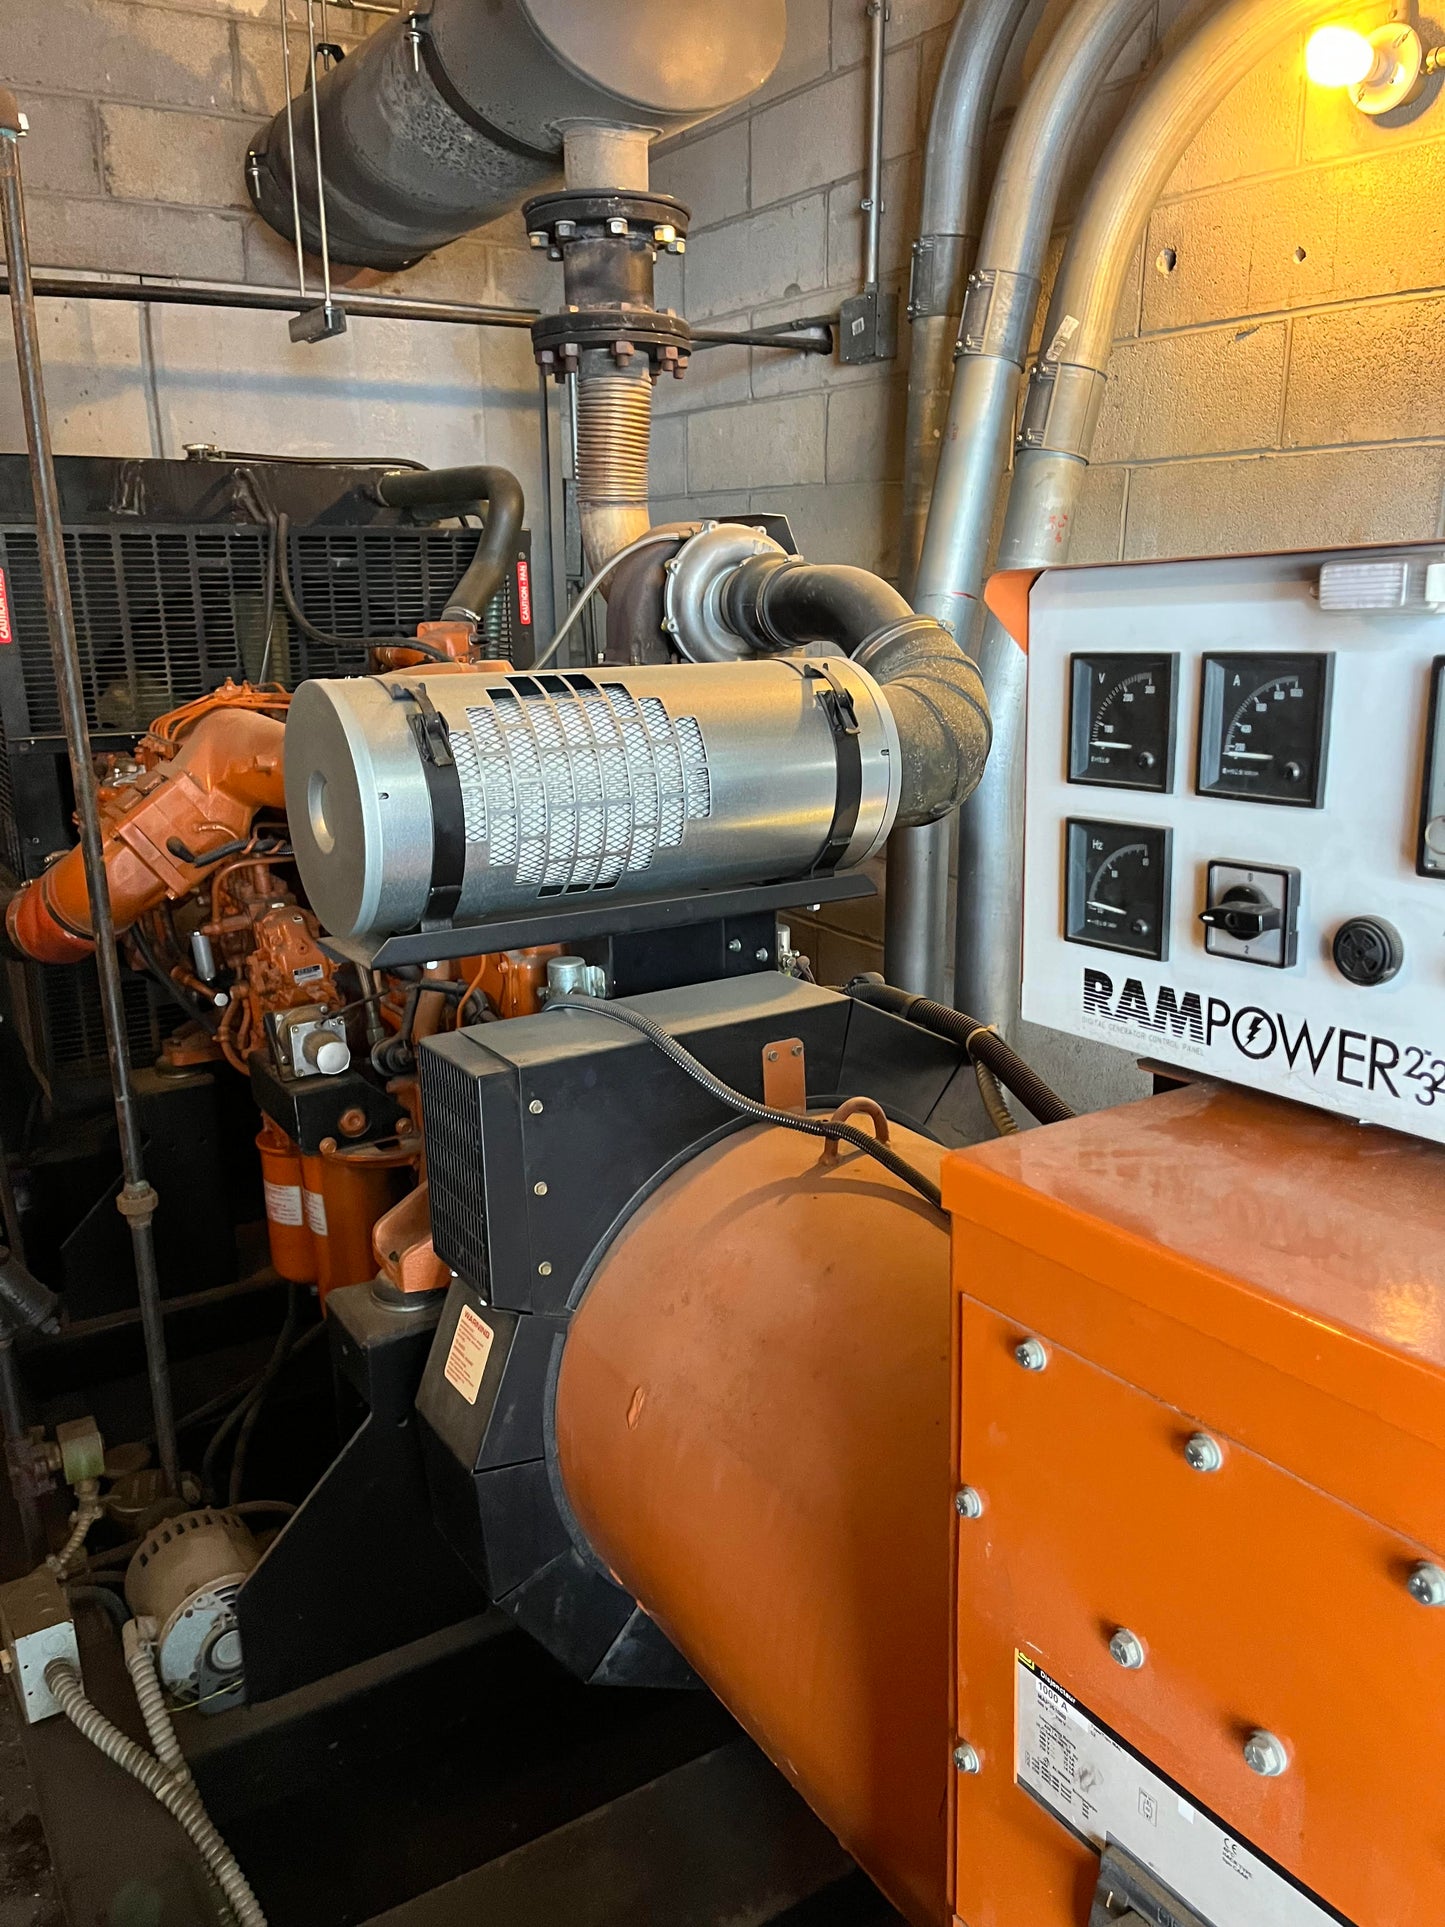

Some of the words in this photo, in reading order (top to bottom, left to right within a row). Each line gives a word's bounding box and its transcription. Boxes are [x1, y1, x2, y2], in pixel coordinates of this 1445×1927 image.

[521, 586, 529, 620] CAUTION
[1098, 673, 1106, 684] V
[1233, 674, 1242, 687] A
[1092, 839, 1104, 851] Hz
[1243, 945, 1250, 955] 2
[1081, 1016, 1105, 1031] DIGITAL
[1109, 1023, 1145, 1040] GENERATOR
[1148, 1033, 1179, 1049] CONTROL
[1182, 1042, 1204, 1057] PANEL
[464, 1311, 490, 1339] WARNING
[1038, 1682, 1059, 1704] 1000
[1061, 1702, 1068, 1714] A
